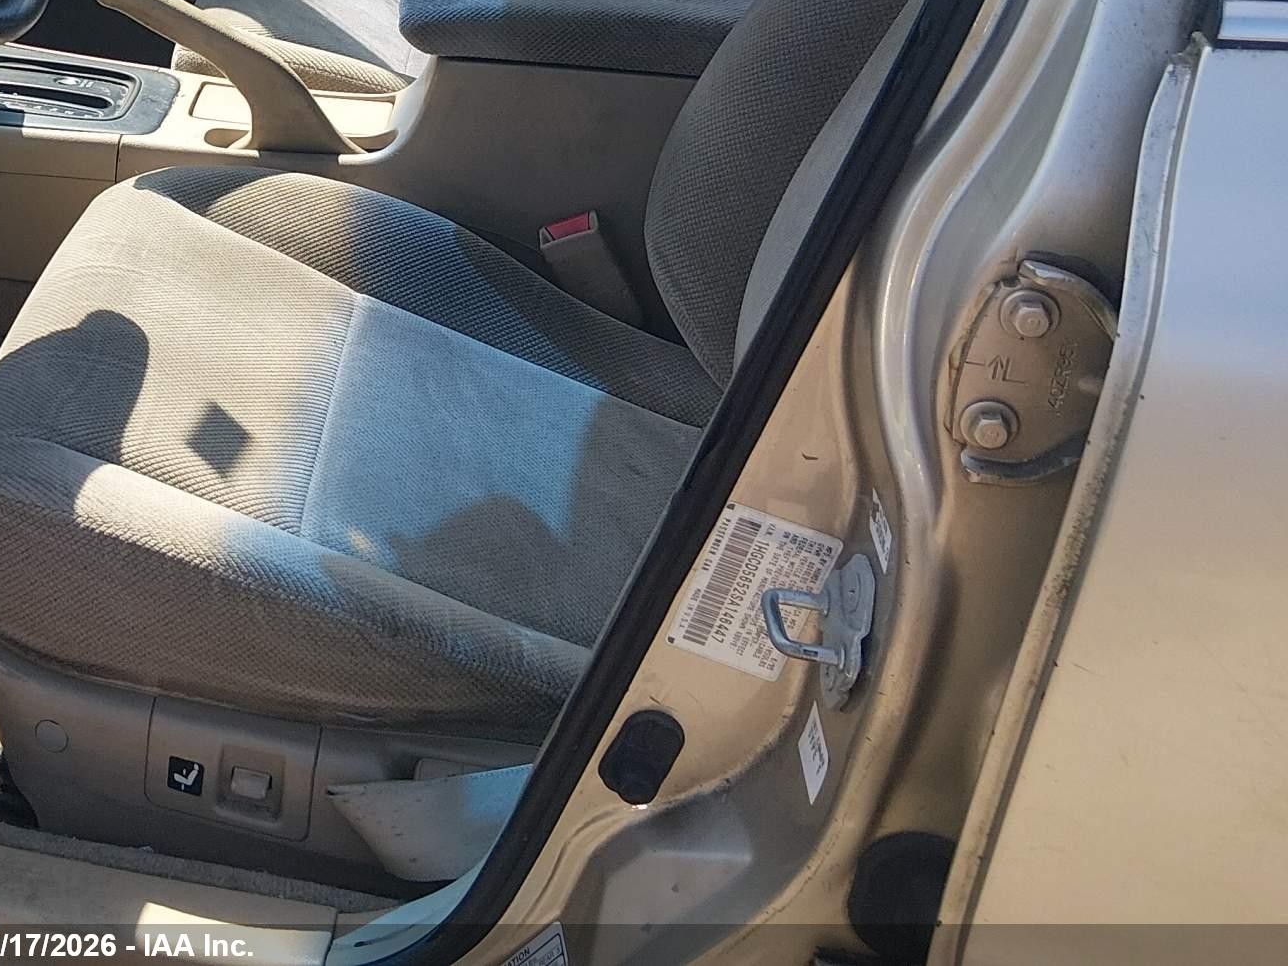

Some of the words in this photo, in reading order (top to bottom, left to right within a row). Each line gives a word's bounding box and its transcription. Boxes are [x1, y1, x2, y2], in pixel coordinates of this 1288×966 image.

[708, 517, 731, 555] PASSENGER
[701, 558, 712, 571] CAR
[793, 555, 808, 577] VEHICLE
[714, 541, 769, 642] 1HGCD5652SA146447
